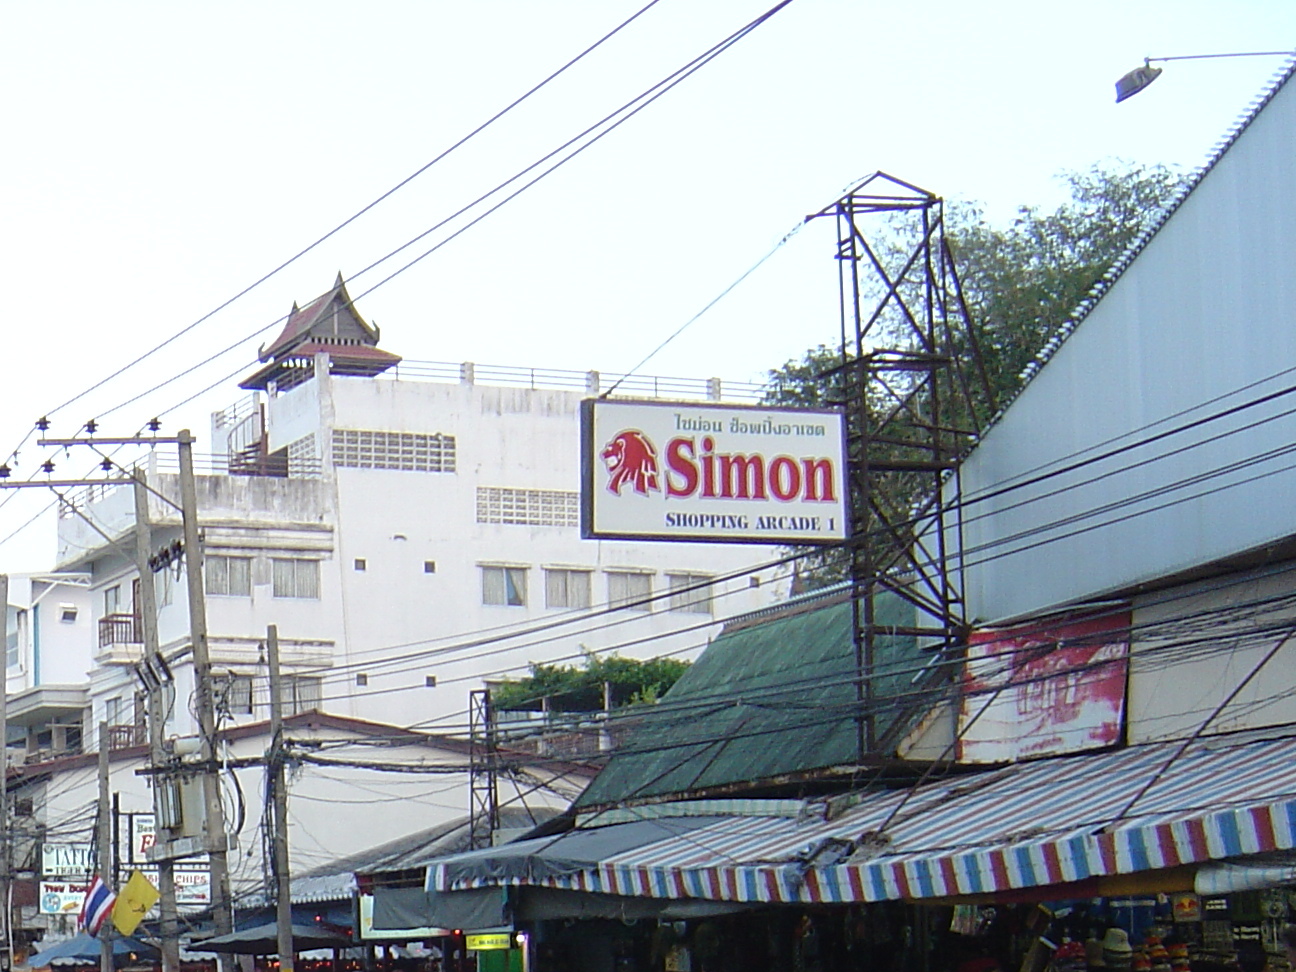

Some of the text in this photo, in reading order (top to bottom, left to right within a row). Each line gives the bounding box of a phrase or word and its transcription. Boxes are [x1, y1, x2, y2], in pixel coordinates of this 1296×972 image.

[665, 436, 837, 503] Simon
[665, 512, 835, 531] SHOPPING ARCADE 1
[175, 874, 207, 884] CHIPS
